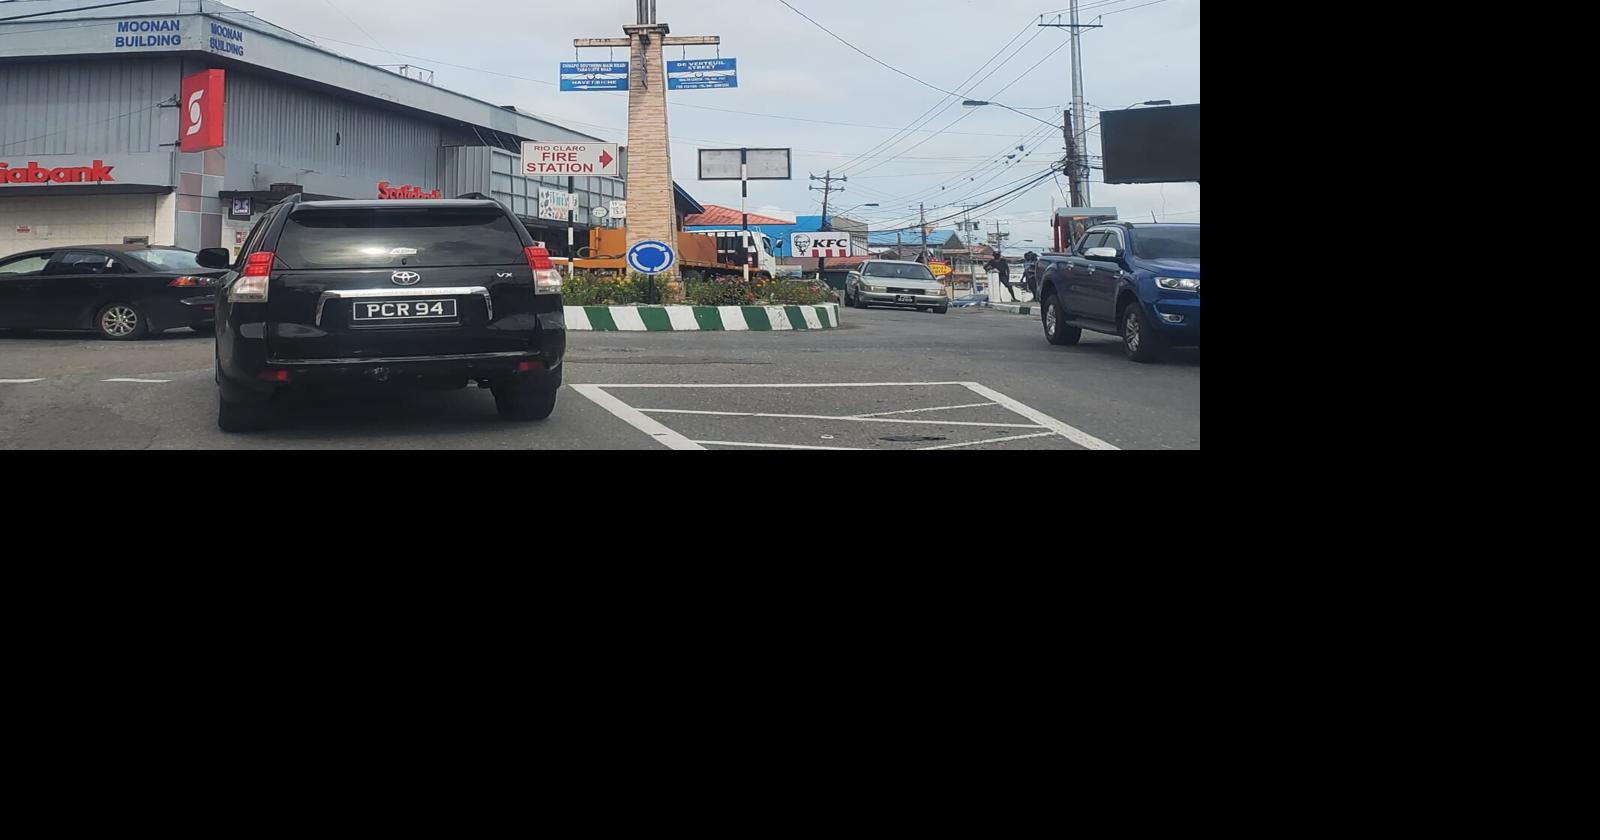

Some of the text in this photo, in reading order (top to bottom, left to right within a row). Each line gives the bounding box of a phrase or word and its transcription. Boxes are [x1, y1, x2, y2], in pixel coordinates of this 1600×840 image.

[117, 20, 180, 32] MOONAN
[210, 22, 243, 42] MOONAN
[115, 34, 182, 47] BUILDING
[209, 37, 244, 56] BUILDING
[542, 152, 577, 162] FIRE
[526, 162, 594, 173] STATION
[812, 238, 847, 248] KFC
[366, 301, 444, 318] PCR 94
